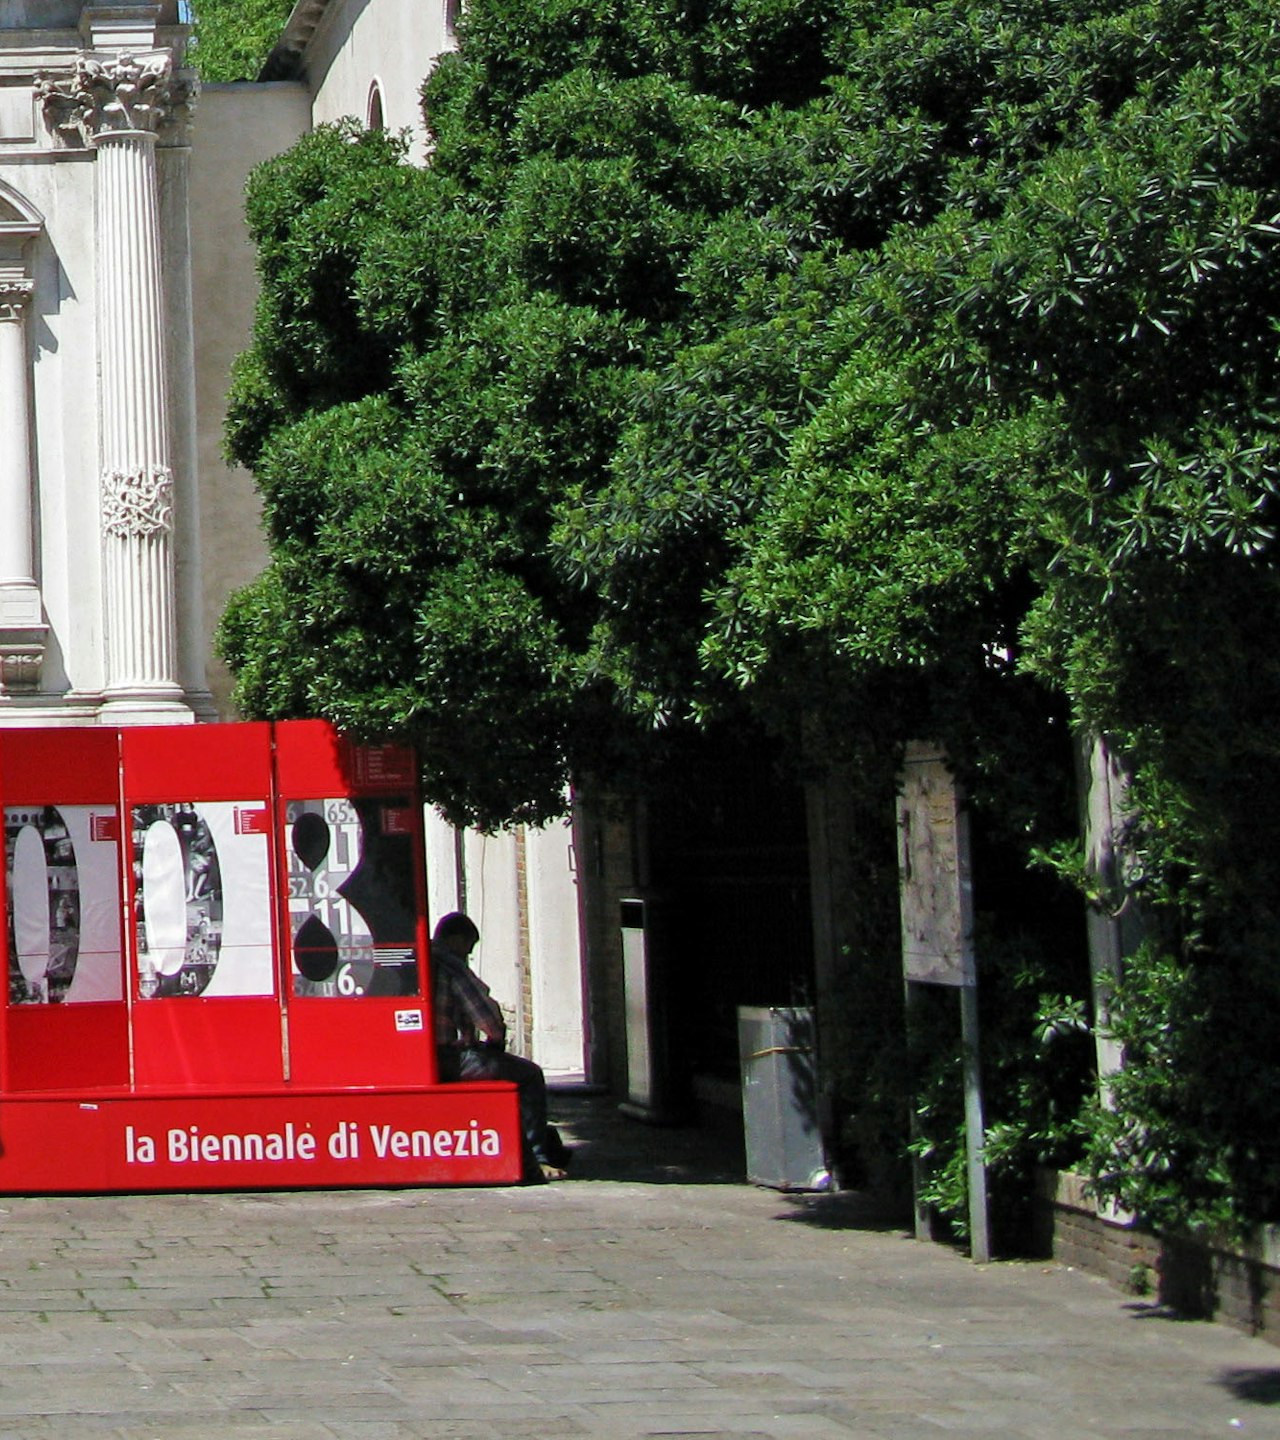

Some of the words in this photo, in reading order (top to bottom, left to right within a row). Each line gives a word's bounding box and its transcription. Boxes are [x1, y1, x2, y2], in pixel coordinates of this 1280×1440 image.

[125, 1126, 156, 1163] la
[167, 1123, 316, 1163] Biennale
[327, 1122, 359, 1160] di
[369, 1119, 501, 1159] Venezia
